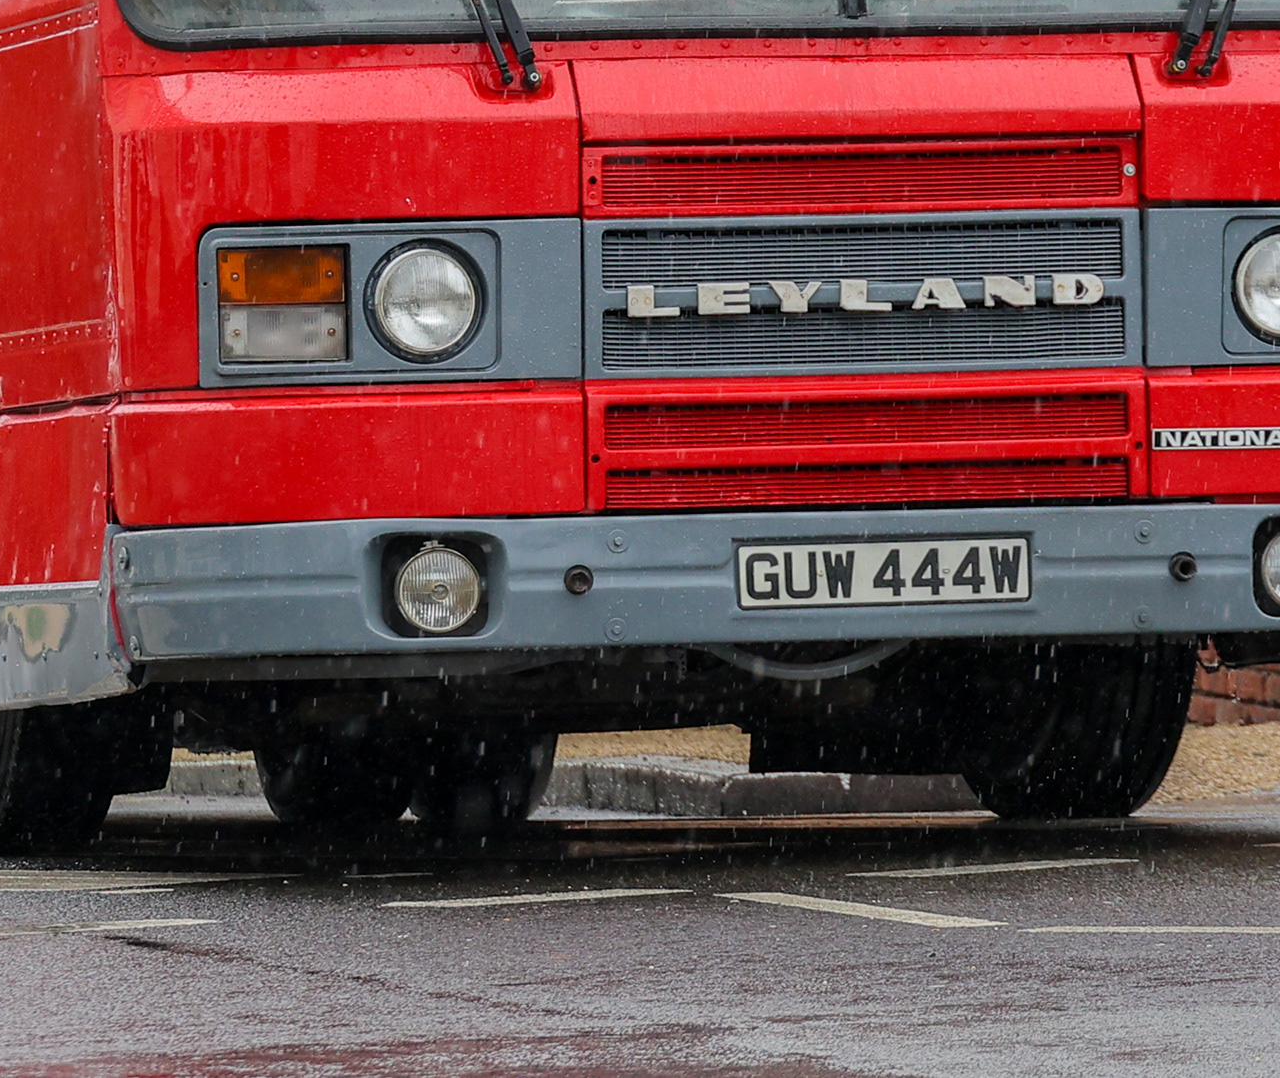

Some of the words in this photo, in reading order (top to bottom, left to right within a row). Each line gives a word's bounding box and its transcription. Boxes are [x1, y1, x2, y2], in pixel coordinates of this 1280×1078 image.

[626, 273, 1106, 317] LEYLAND
[745, 549, 855, 600] GUW
[873, 546, 1022, 597] 444W
